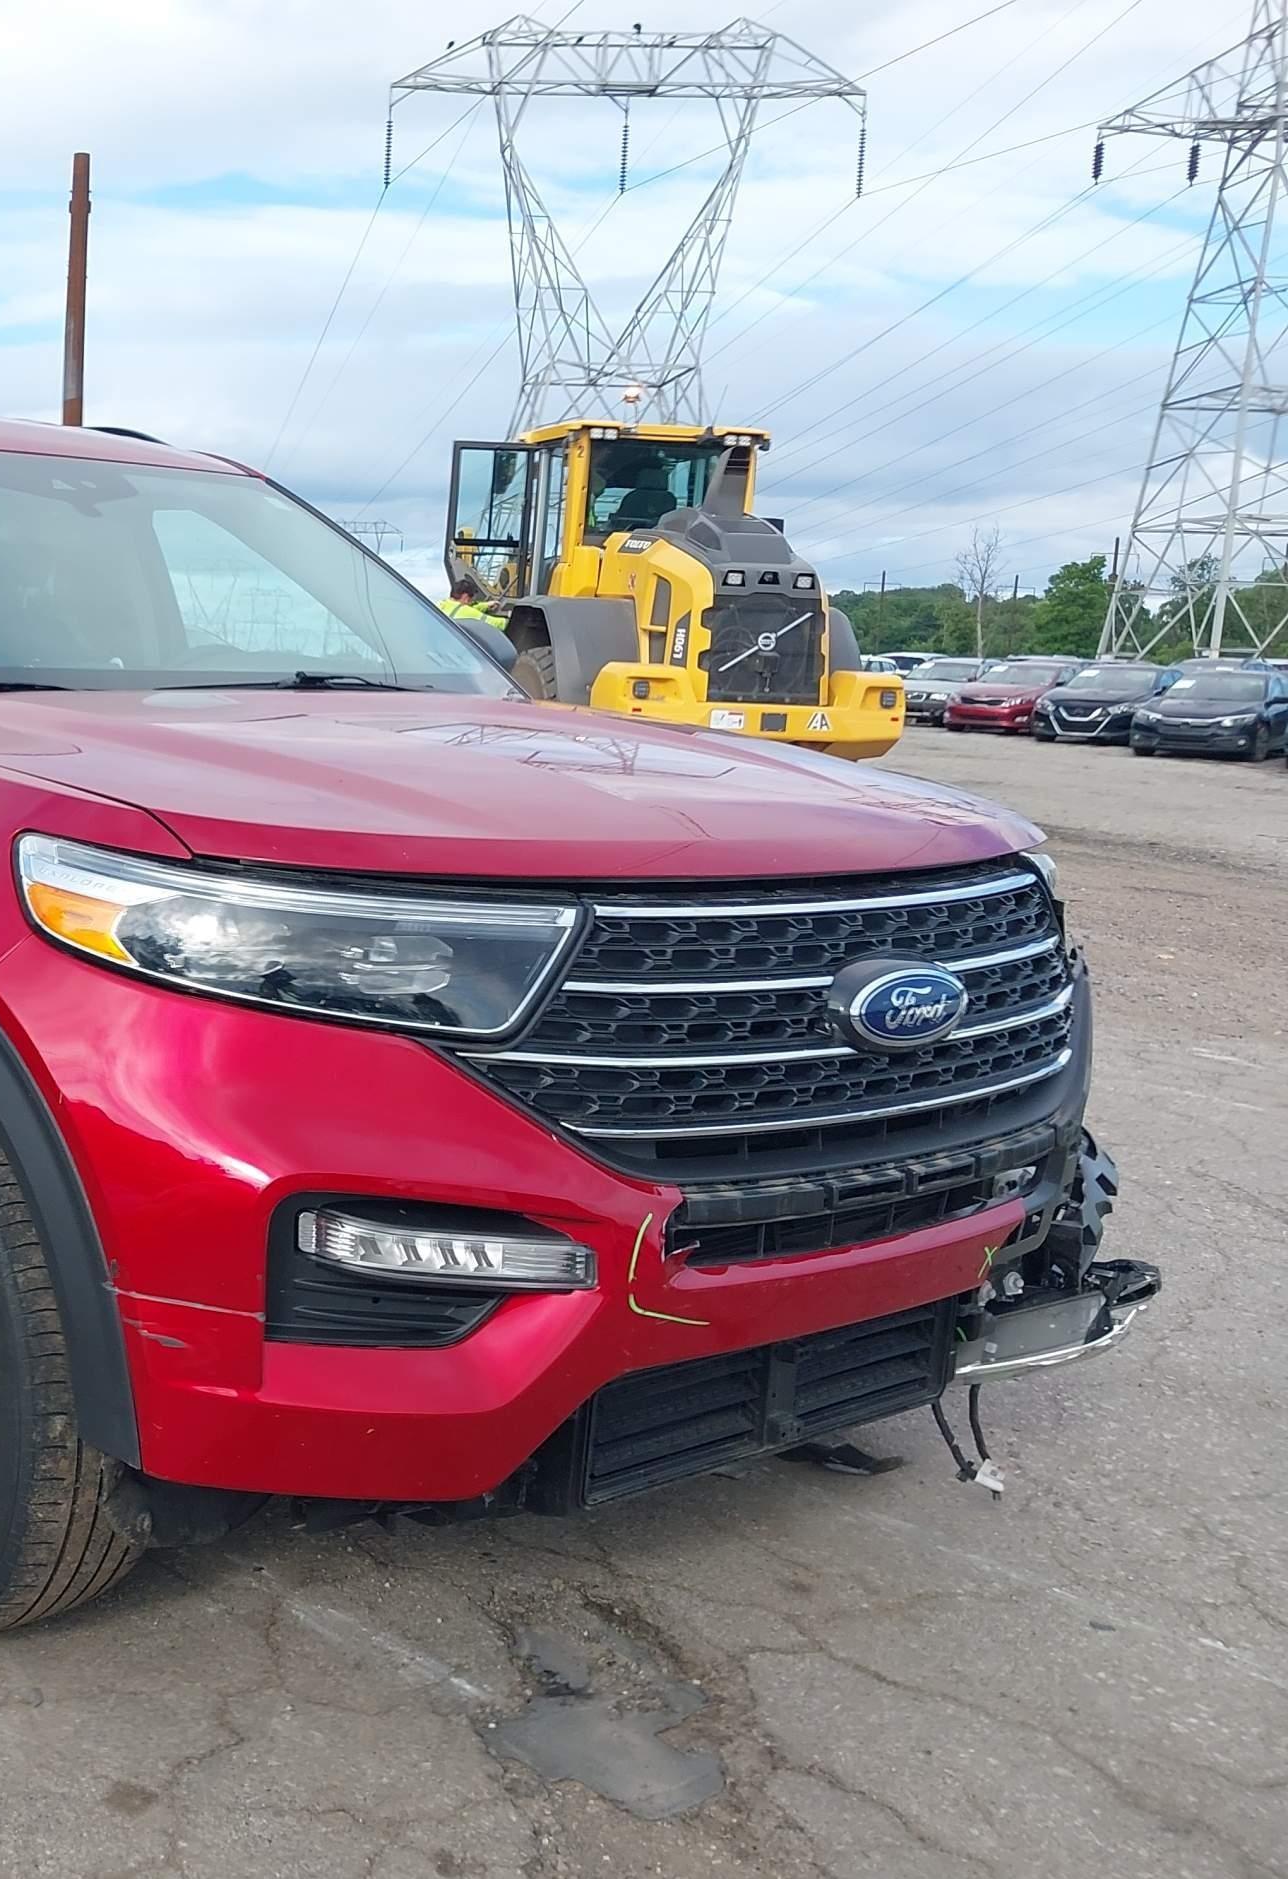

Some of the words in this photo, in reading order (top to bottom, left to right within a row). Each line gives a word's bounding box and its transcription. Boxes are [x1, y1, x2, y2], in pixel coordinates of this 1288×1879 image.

[672, 628, 687, 659] L90H
[38, 865, 128, 895] EXPLORE
[884, 985, 953, 1030] Ford
